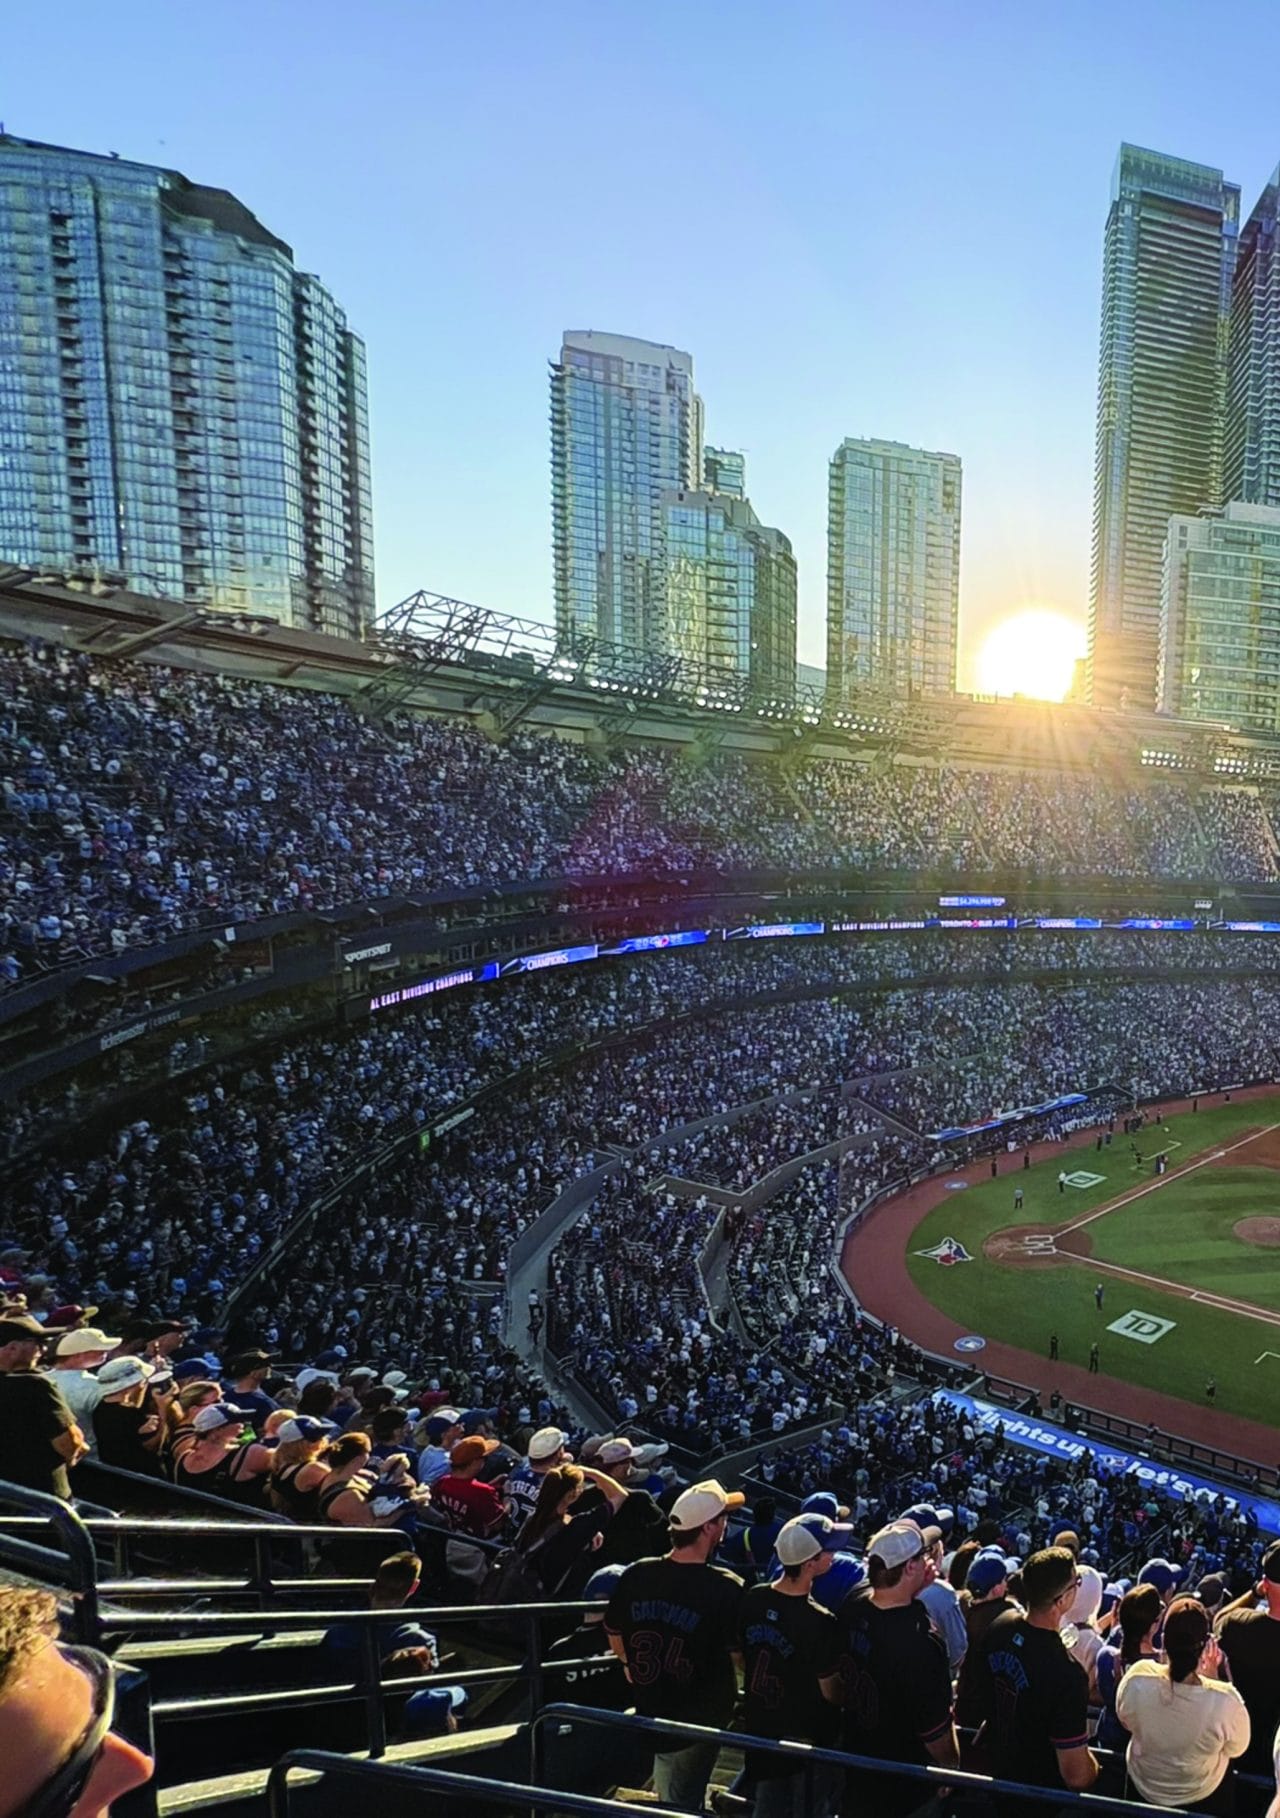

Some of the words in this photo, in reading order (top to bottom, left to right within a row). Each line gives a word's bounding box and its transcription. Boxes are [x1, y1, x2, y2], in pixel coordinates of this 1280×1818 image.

[753, 927, 794, 938] CHAMPIONS
[859, 922, 888, 930] DIVISION
[890, 921, 925, 929] CHAMPIONS
[344, 942, 393, 963] SPORTSNET
[527, 953, 569, 971] CHAMPIONS
[369, 998, 380, 1011] AL
[381, 991, 401, 1007] EAST
[402, 981, 434, 1001] DIVISION
[435, 970, 474, 991] CHAMPIONS
[1124, 1314, 1164, 1336] TD
[631, 1599, 702, 1633] GAUSMAN
[628, 1629, 695, 1686] 34
[749, 1643, 781, 1701] 4
